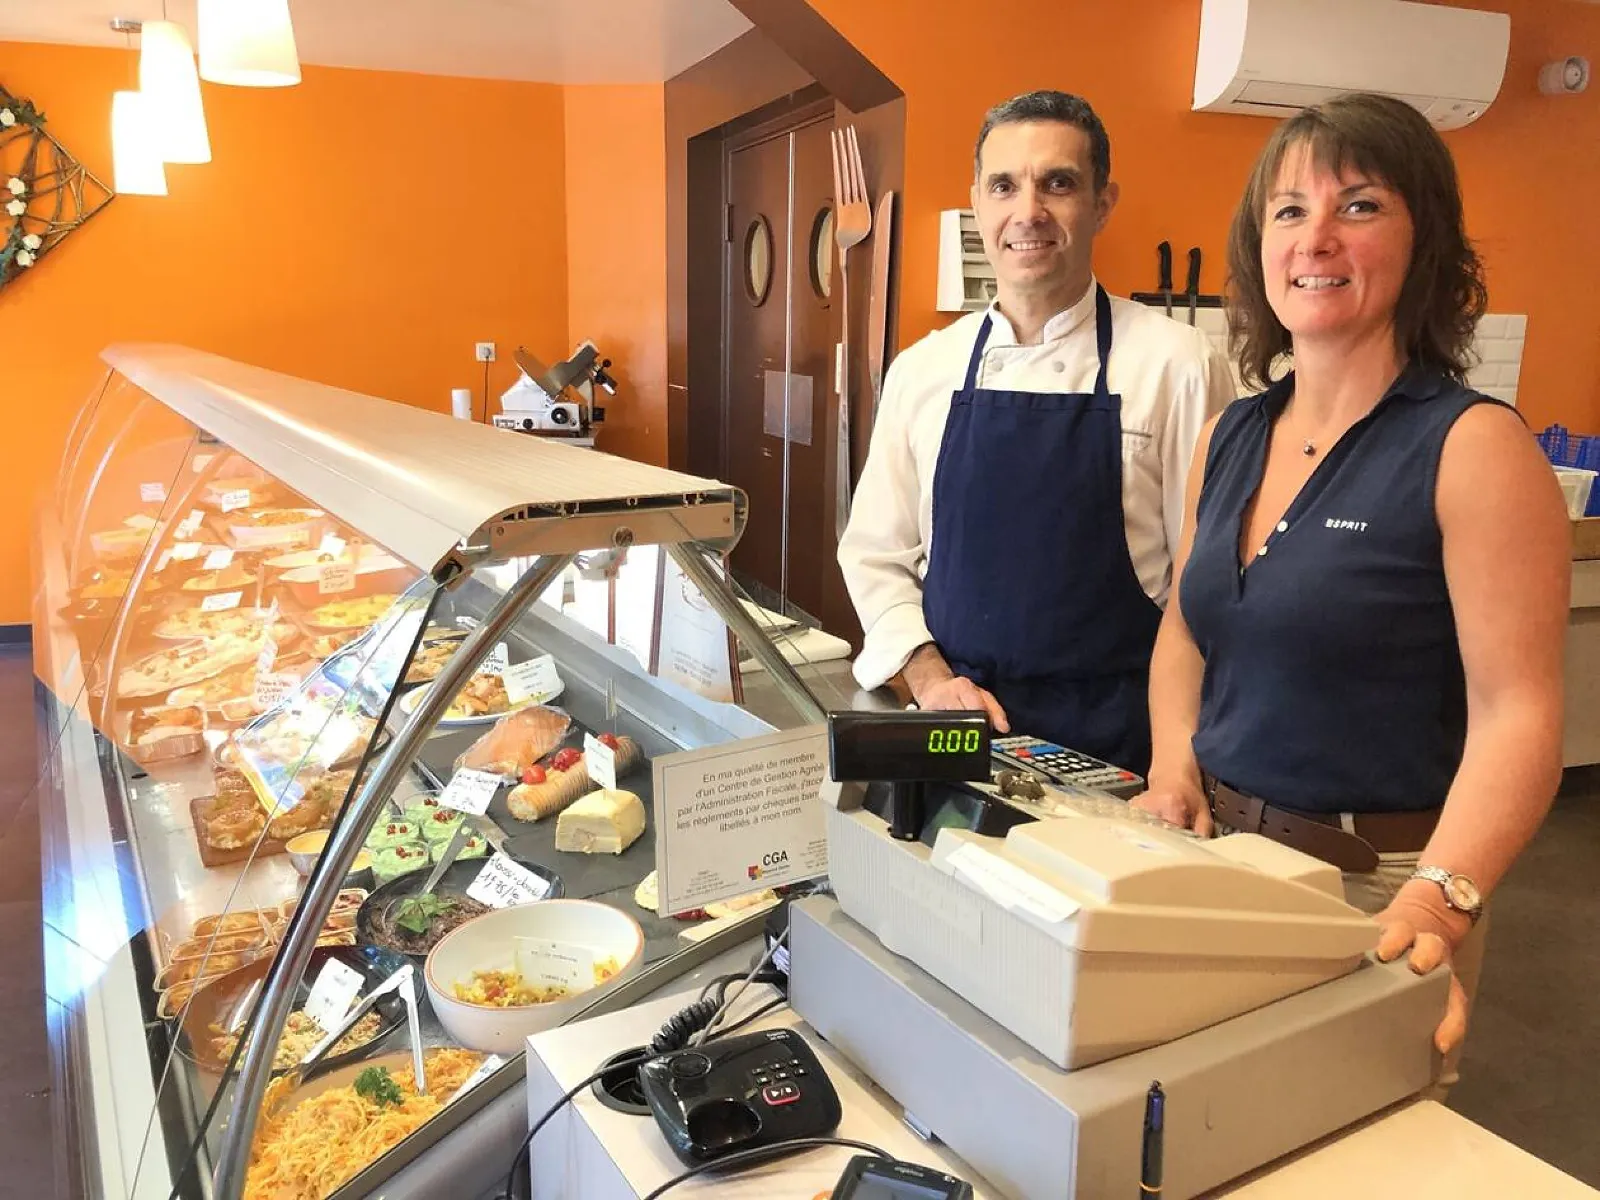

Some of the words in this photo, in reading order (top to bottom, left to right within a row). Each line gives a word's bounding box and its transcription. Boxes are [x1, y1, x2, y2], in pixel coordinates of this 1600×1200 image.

[1324, 517, 1369, 533] ESPRIT
[927, 729, 980, 753] 0.00
[702, 773, 717, 783] En
[717, 770, 733, 779] ma
[734, 762, 765, 777] qualité
[766, 761, 778, 770] de
[780, 752, 816, 767] membre
[695, 787, 716, 799] d'un
[717, 781, 749, 793] Centre
[749, 777, 762, 787] de
[763, 770, 798, 783] Gestion
[676, 806, 693, 818] par
[745, 804, 760, 815] par
[761, 811, 781, 822] mon
[762, 850, 789, 866] CGA
